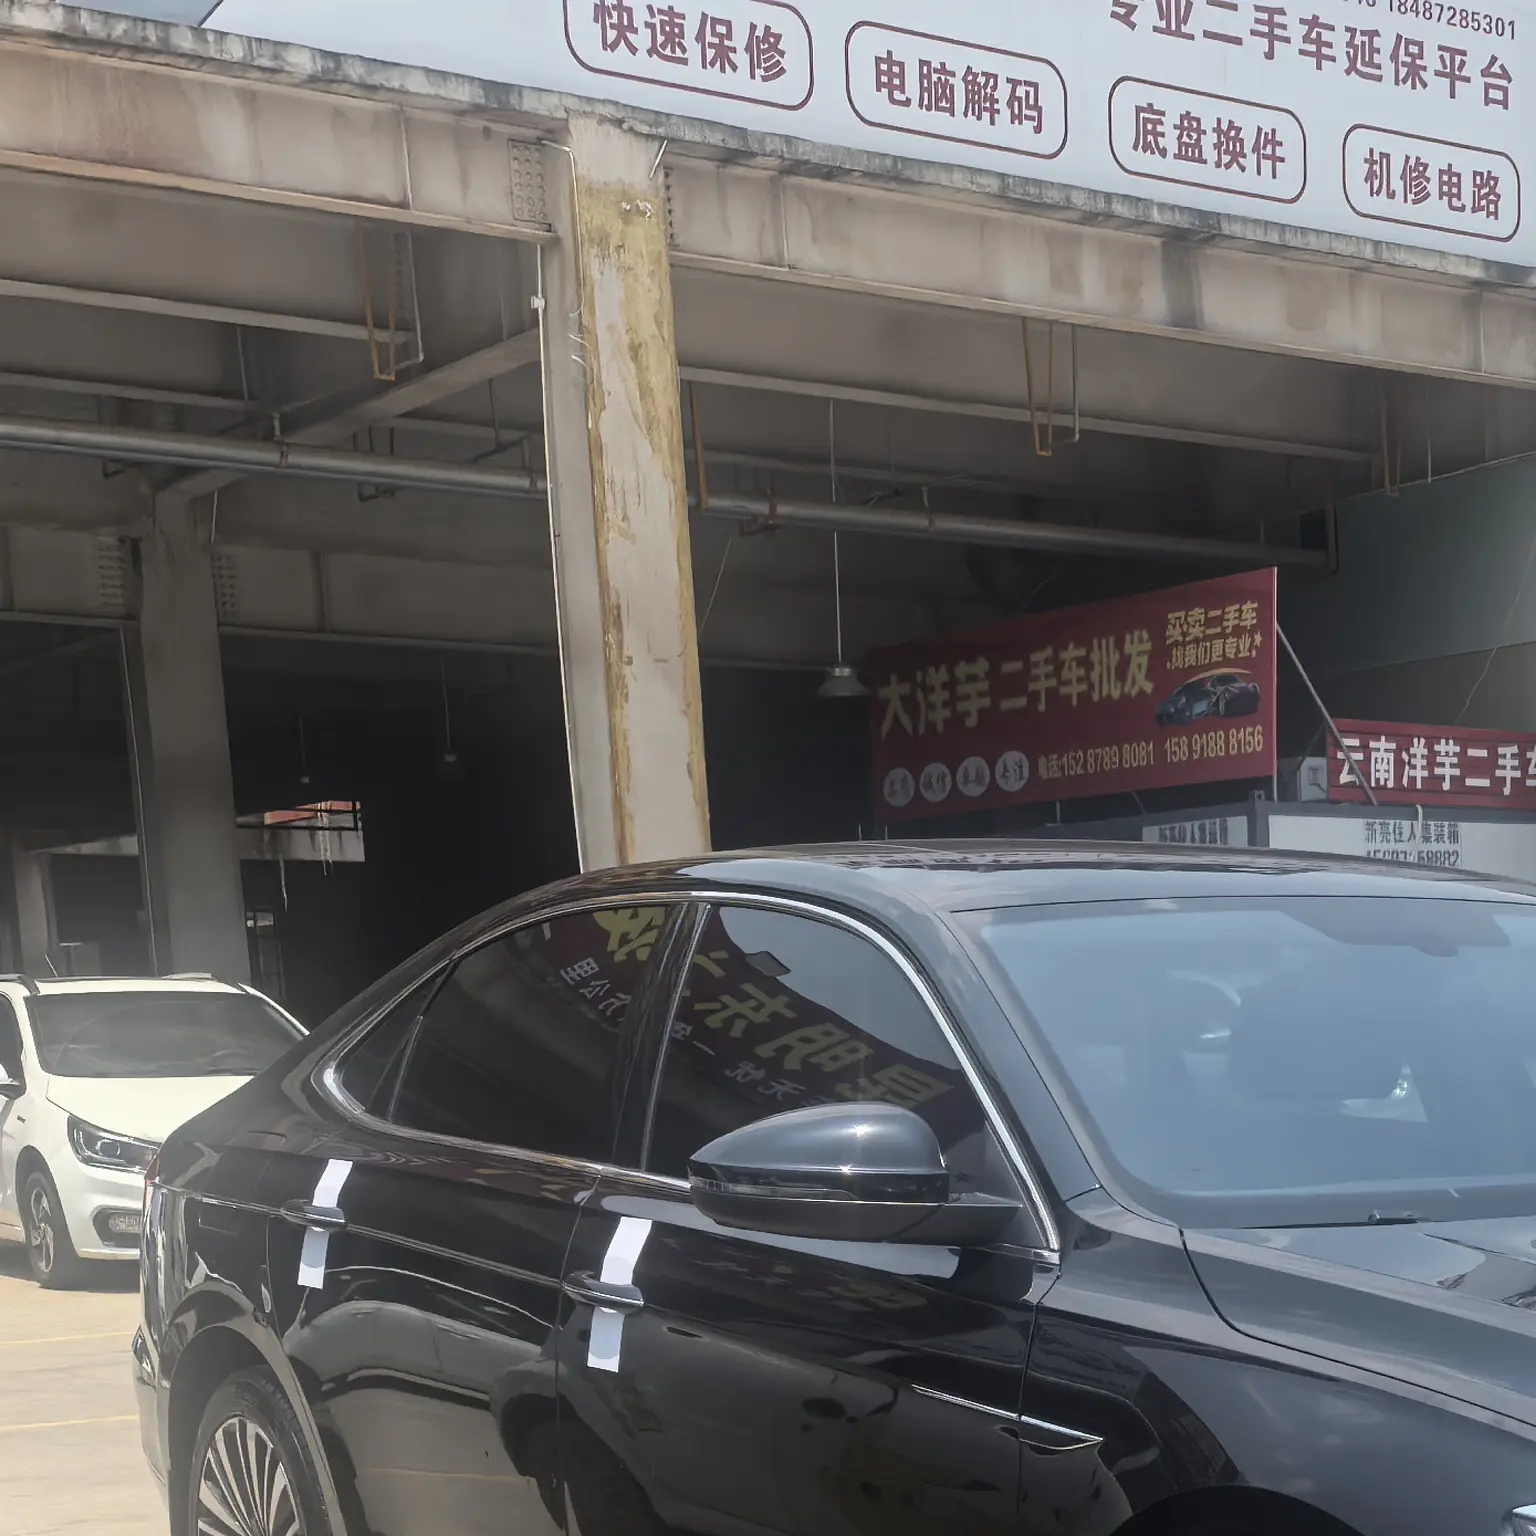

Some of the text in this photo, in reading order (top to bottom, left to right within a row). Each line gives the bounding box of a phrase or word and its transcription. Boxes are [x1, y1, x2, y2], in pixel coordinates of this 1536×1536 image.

[592, 0, 787, 83] 快速保修
[873, 49, 1045, 136] 电脑解码
[1132, 102, 1286, 181] 底盘换件
[1363, 146, 1502, 221] 机修电路
[1165, 600, 1259, 645] 买卖二手车
[877, 629, 1155, 741] 大洋芋二手车批发
[1121, 739, 1155, 769] 8081
[1164, 734, 1188, 764] 158
[1191, 729, 1225, 760] 9188
[1228, 724, 1264, 756] 8156
